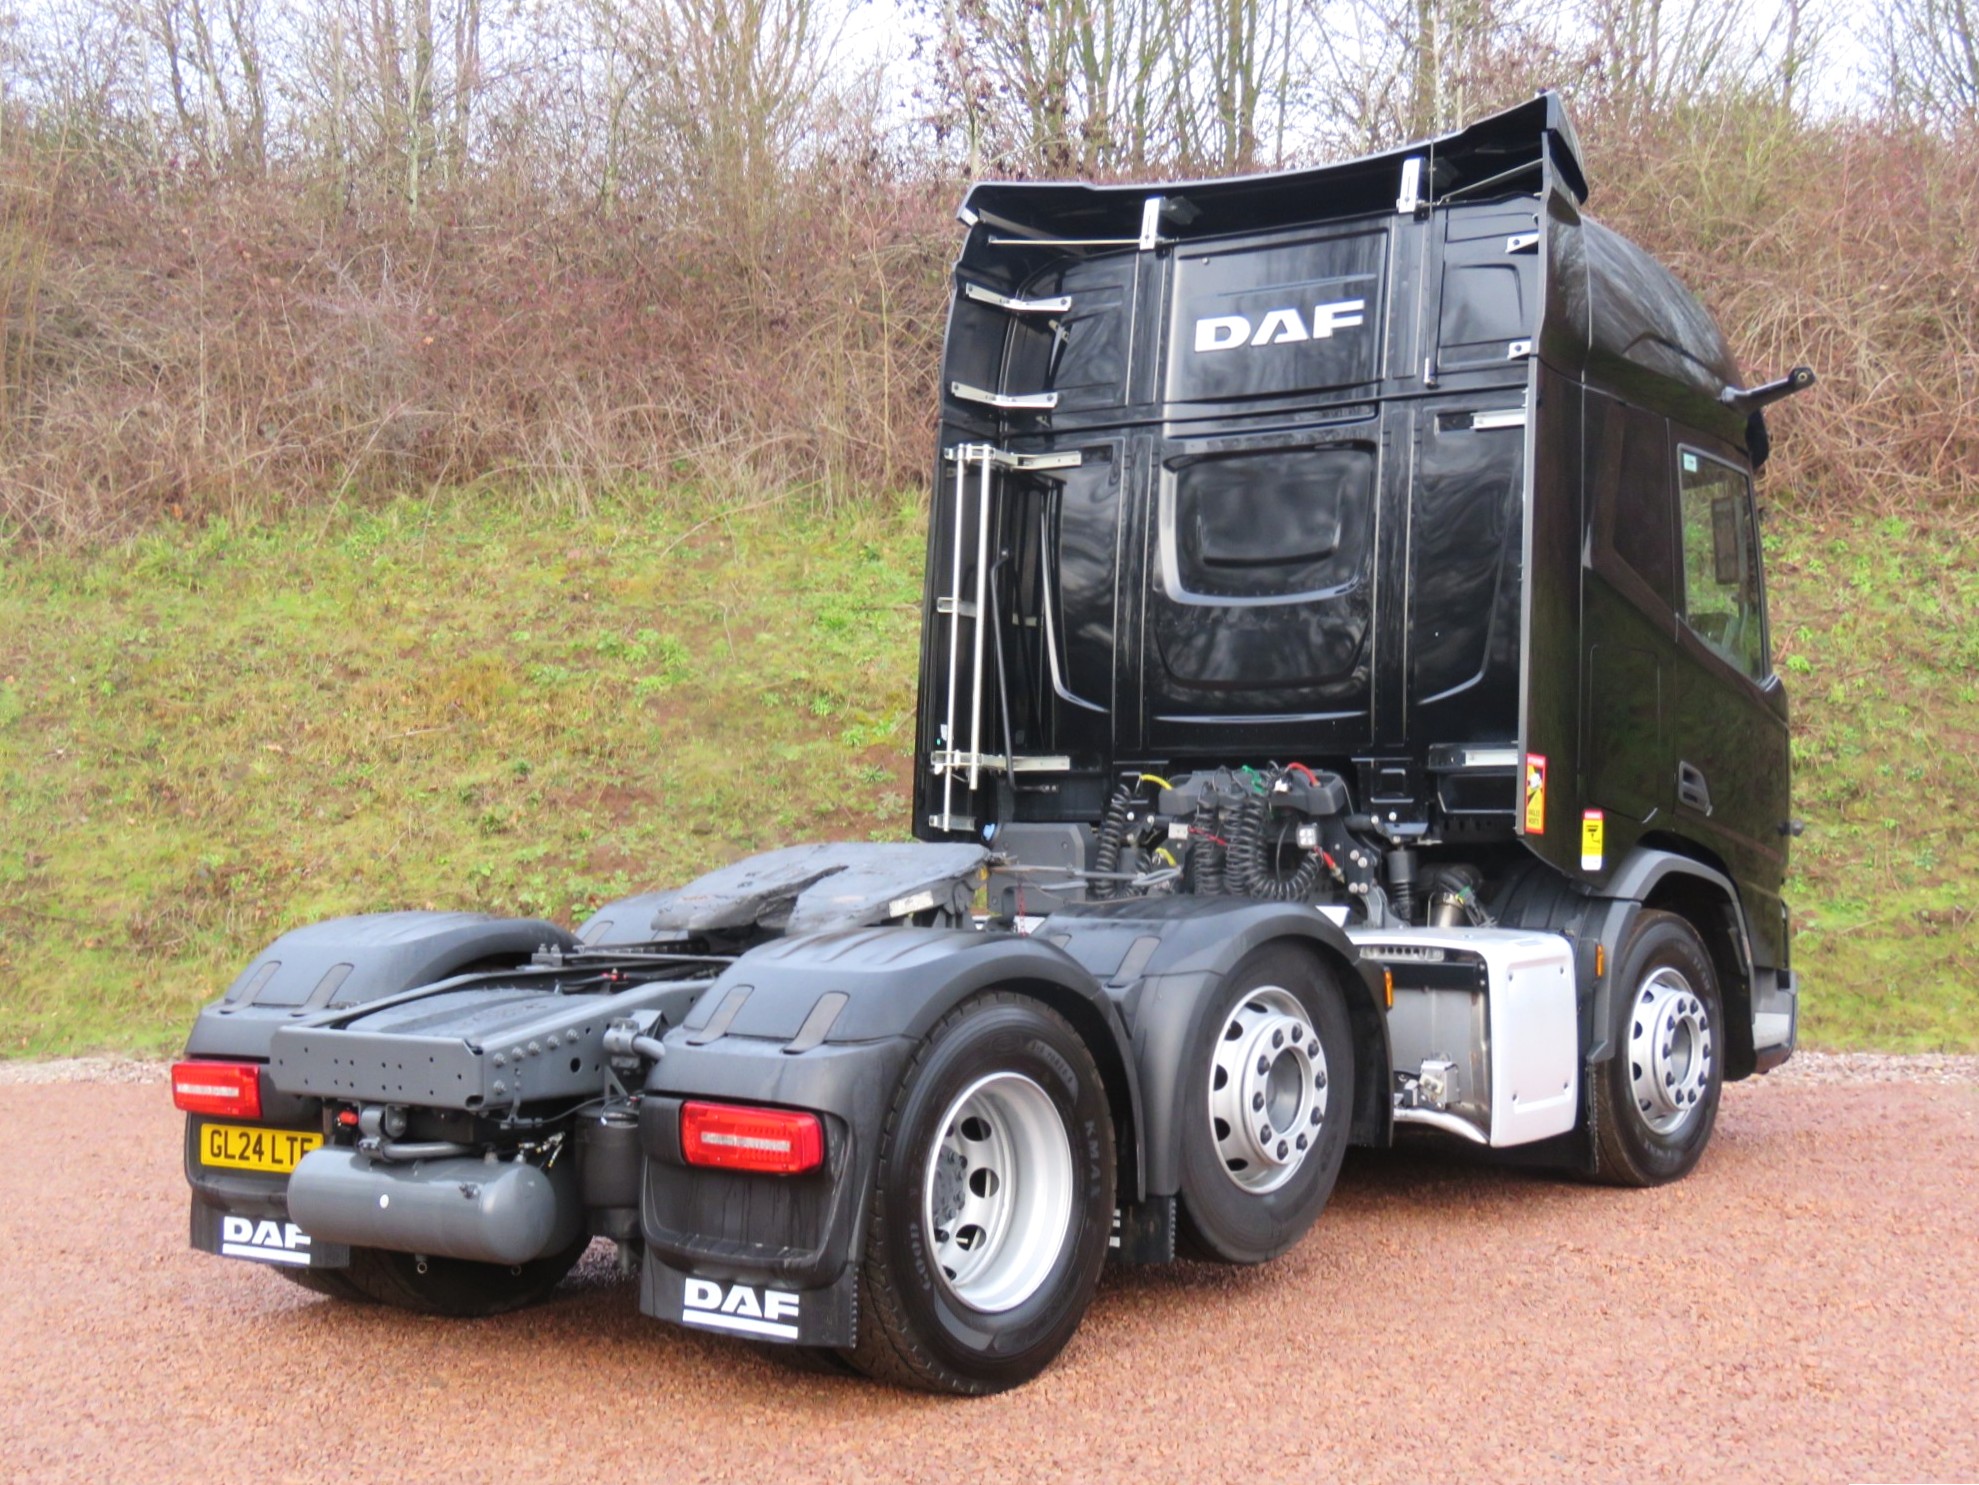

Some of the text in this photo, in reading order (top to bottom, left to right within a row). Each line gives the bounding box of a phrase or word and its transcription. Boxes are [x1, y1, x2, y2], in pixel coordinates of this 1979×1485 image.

[1195, 299, 1365, 352] DAF
[210, 1129, 265, 1163] GL24
[223, 1215, 311, 1249] DAF
[684, 1277, 800, 1321] DAF
